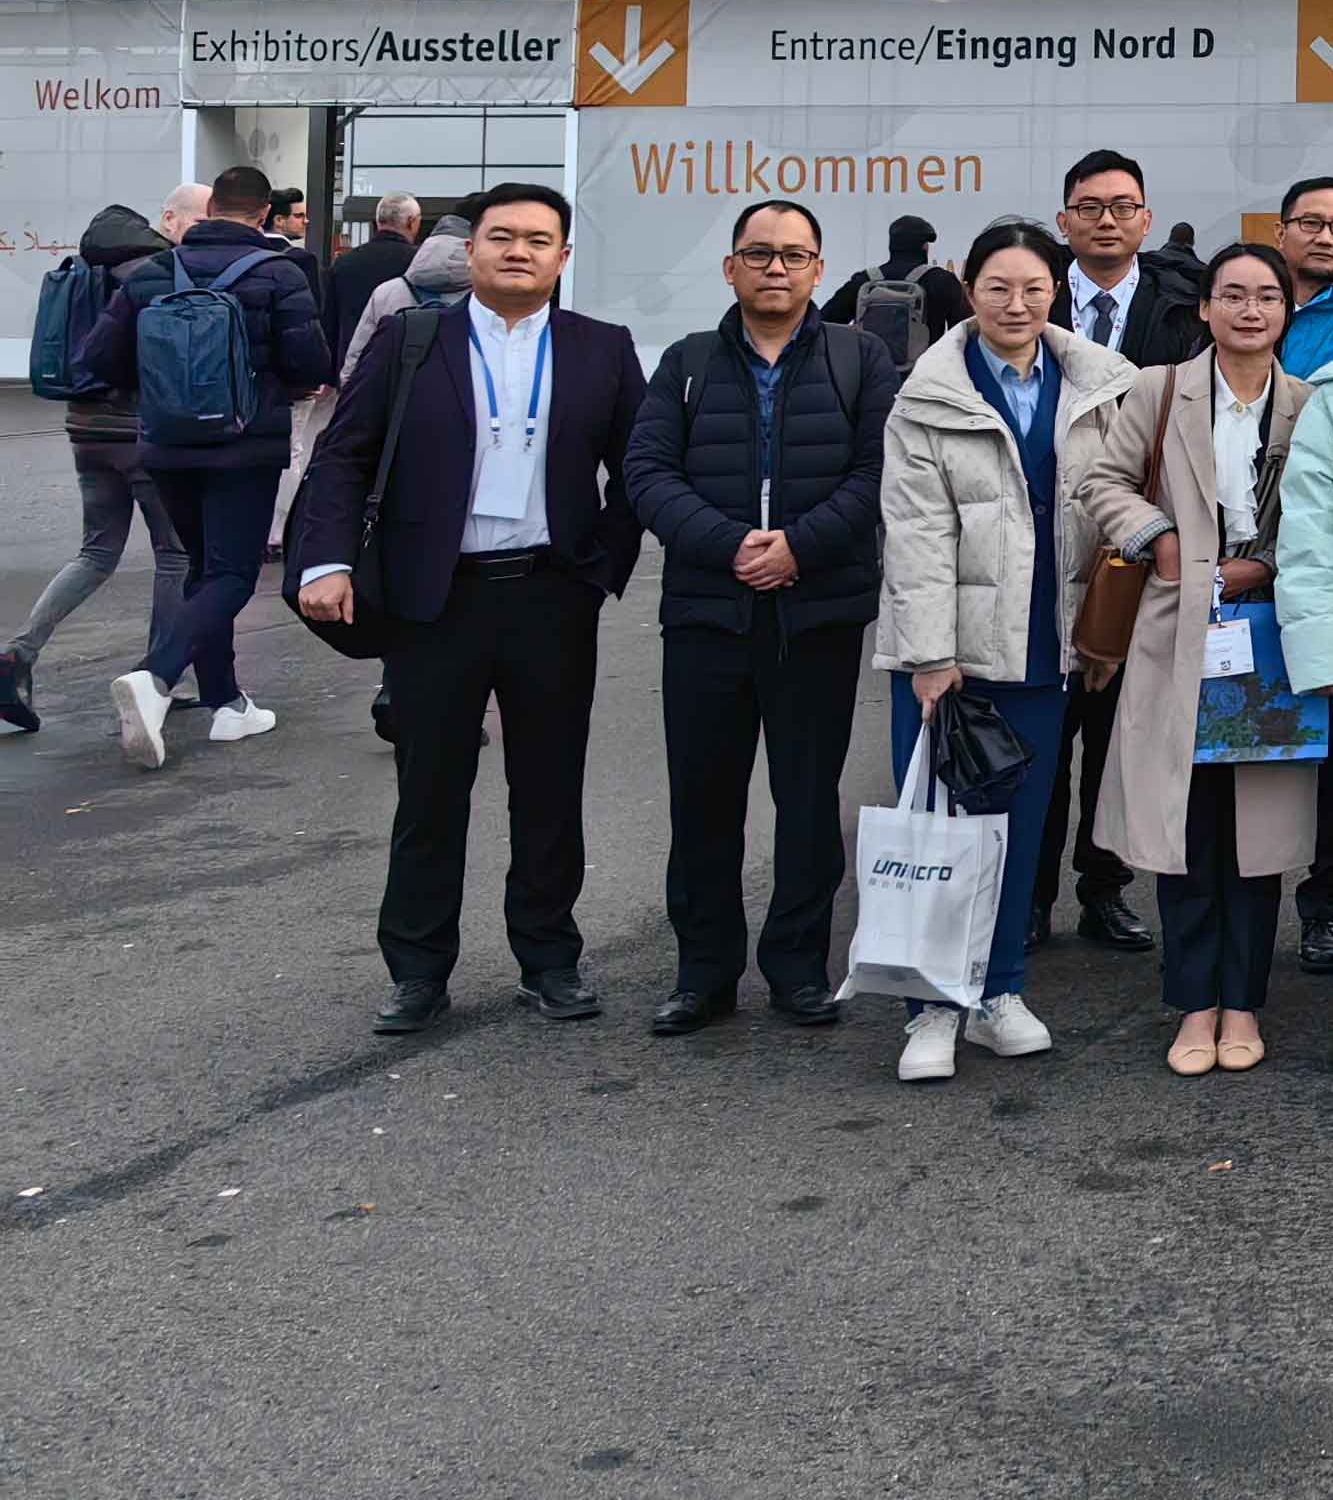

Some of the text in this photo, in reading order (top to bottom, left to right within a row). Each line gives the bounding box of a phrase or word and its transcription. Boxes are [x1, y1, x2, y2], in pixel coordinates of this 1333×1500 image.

[191, 27, 562, 67] Exhibitors/Aussteller
[770, 25, 1215, 68] Entrance/Eingang Nord D
[36, 78, 160, 110] Welkom
[630, 141, 983, 195] Willkommen
